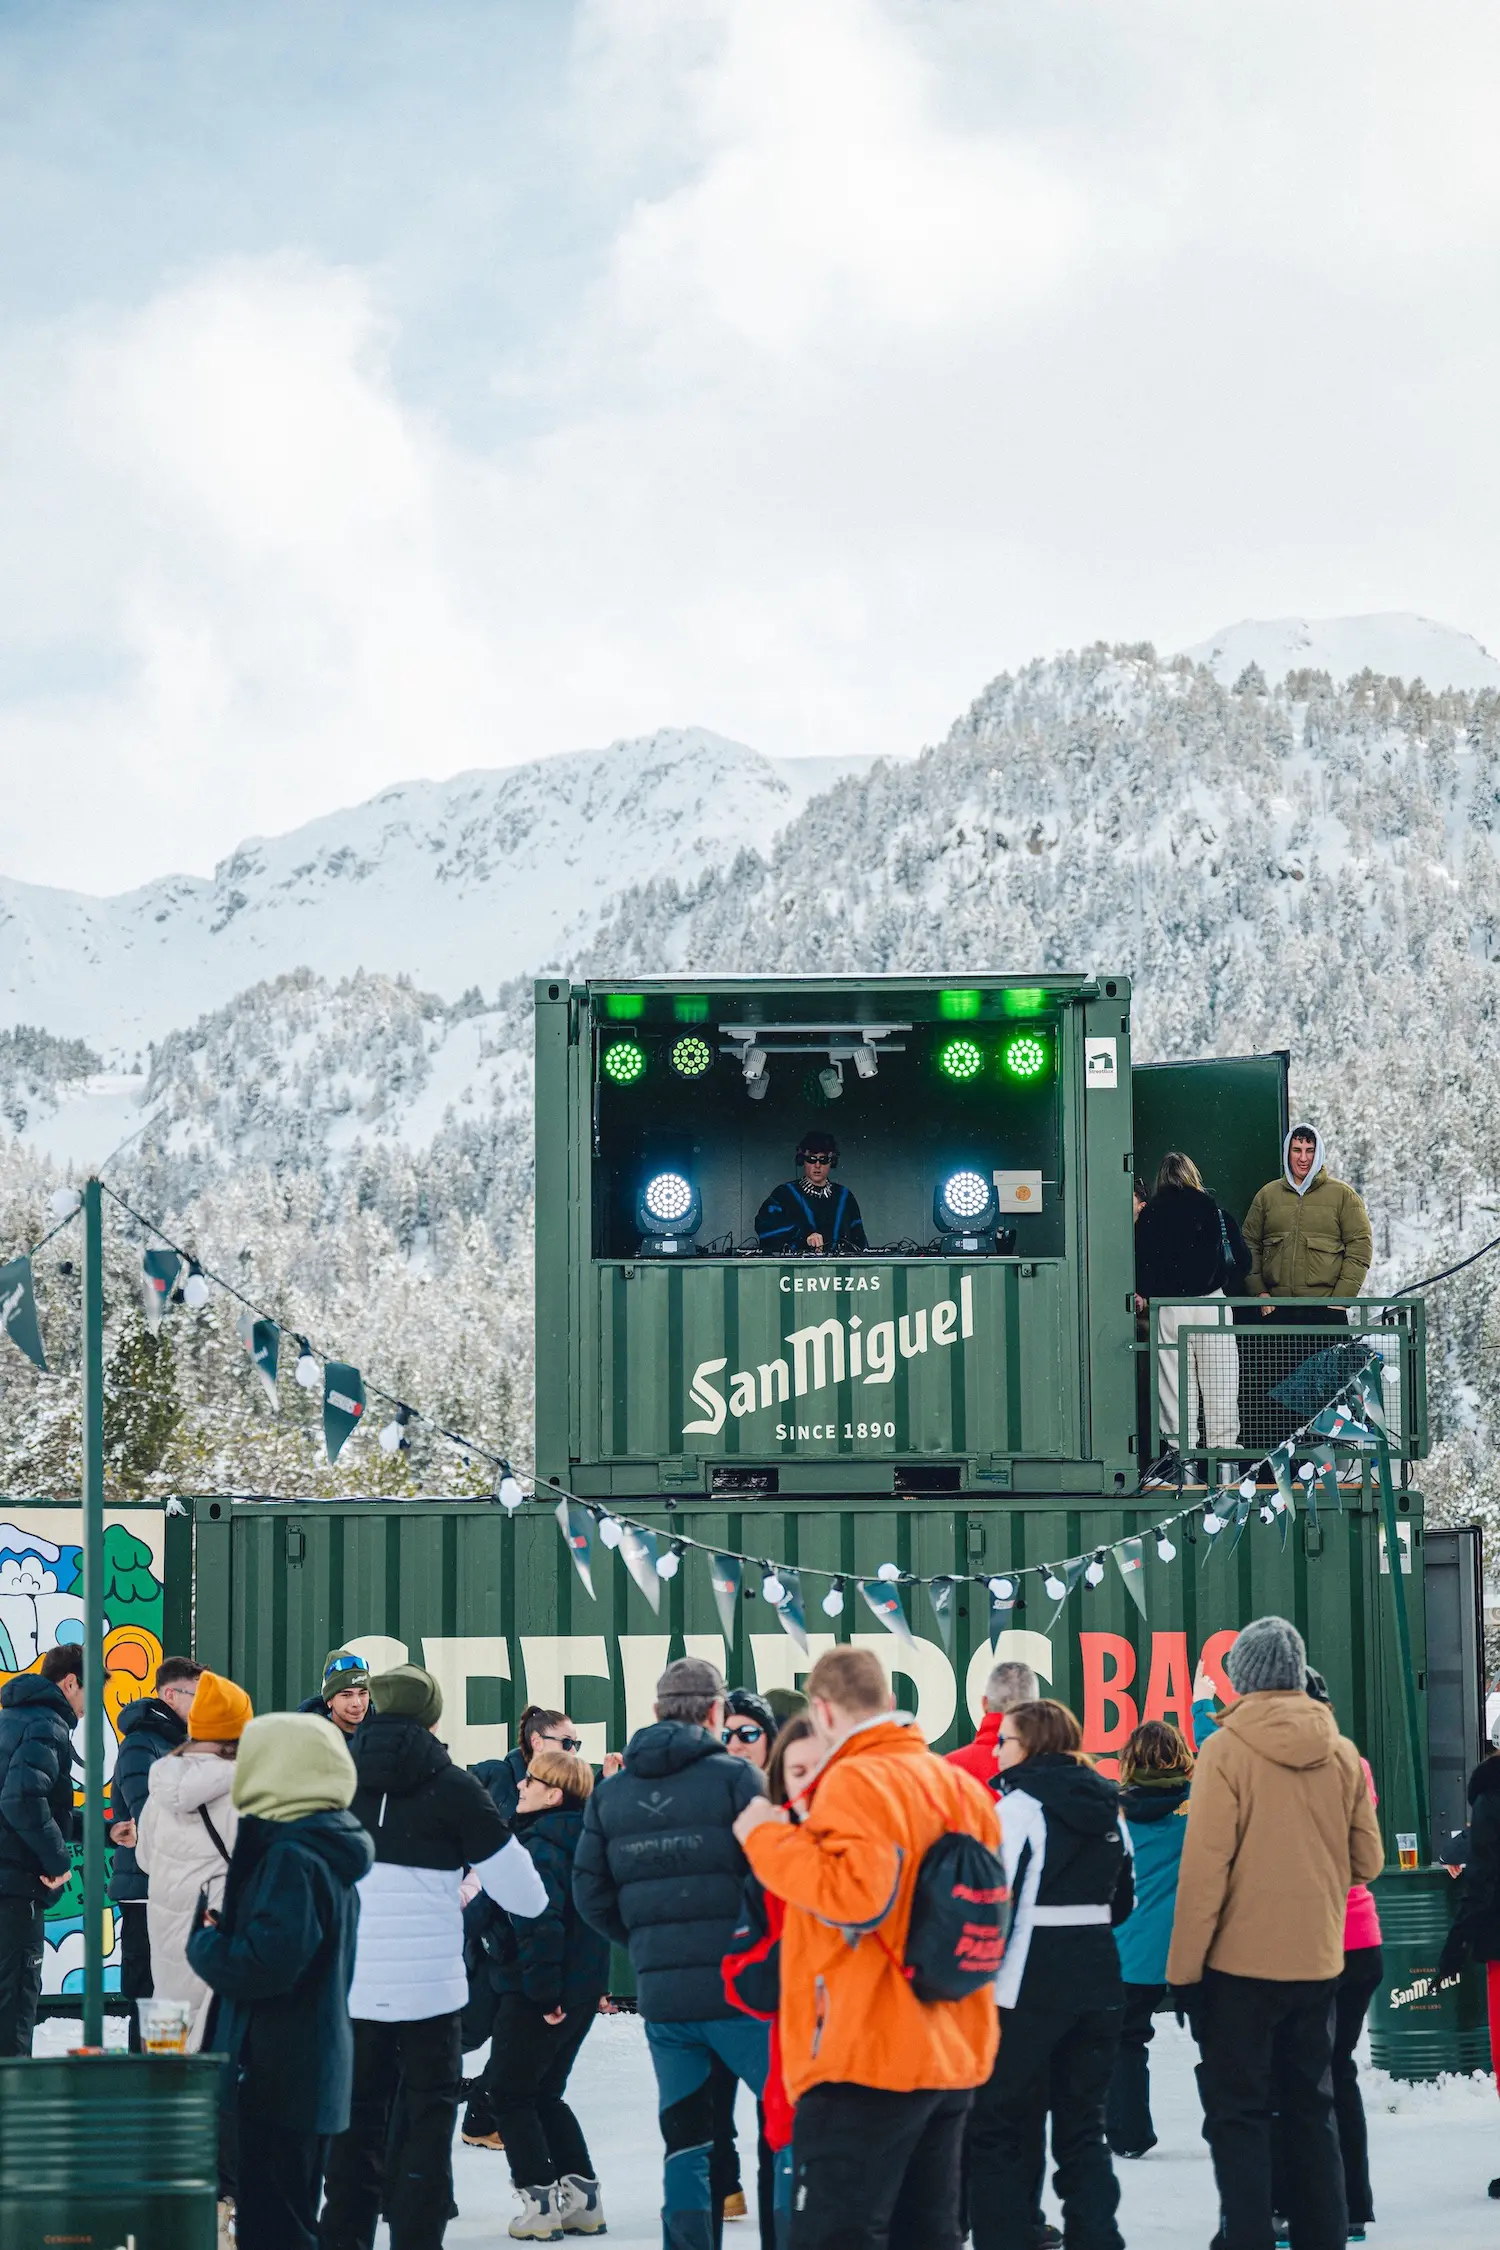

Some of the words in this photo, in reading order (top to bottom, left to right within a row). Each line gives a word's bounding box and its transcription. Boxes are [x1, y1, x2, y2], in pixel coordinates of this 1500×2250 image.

[779, 1275, 881, 1293] CERVEZAS
[775, 1423, 836, 1440] SINCE
[844, 1421, 896, 1439] 1890
